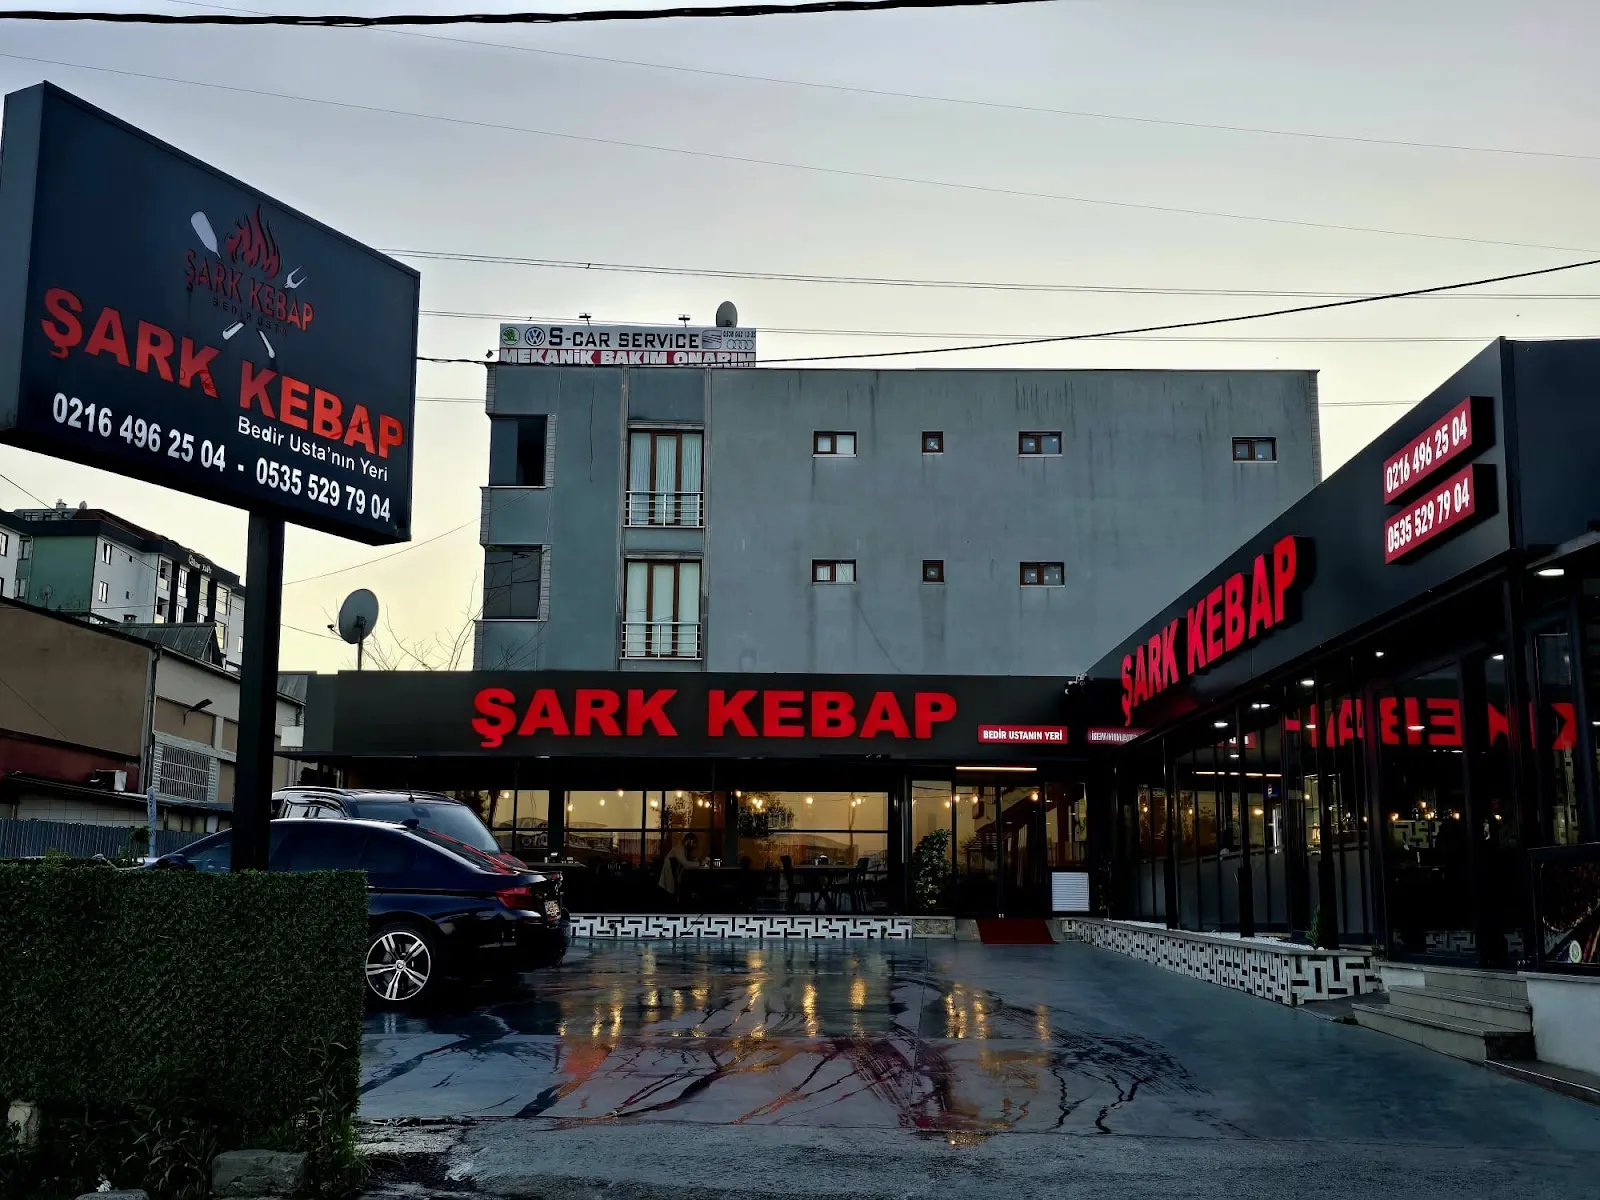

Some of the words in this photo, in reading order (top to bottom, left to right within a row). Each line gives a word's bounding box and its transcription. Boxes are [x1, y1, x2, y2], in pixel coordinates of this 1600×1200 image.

[185, 248, 243, 304] ŞARK
[250, 277, 314, 331] KEBAP
[40, 287, 221, 398] ŞARK
[238, 361, 404, 459] KEBAP
[549, 327, 610, 347] S-CAR
[602, 351, 667, 365] BAKIM
[53, 392, 113, 438] 0216
[119, 415, 162, 452] 496
[167, 428, 195, 463] 25
[200, 439, 226, 472] 04
[256, 457, 302, 496] 0535
[307, 473, 341, 507] 529
[345, 485, 366, 515] 79
[371, 493, 391, 523] 04
[238, 415, 284, 446] Bedir
[360, 457, 388, 482] Yeri
[1386, 453, 1411, 494] 0216
[1413, 437, 1432, 474] 496
[1434, 424, 1449, 460] 25
[1452, 410, 1467, 447] 04
[1387, 514, 1412, 553] 0535
[1414, 500, 1435, 537] 529
[1437, 490, 1451, 524] 79
[1454, 477, 1470, 513] 04
[1120, 618, 1179, 726] ŞARK
[1186, 534, 1297, 676] KEBAP
[472, 689, 679, 748] ŞARK
[707, 690, 957, 740] KEBAP
[1008, 730, 1043, 741] USTANIN
